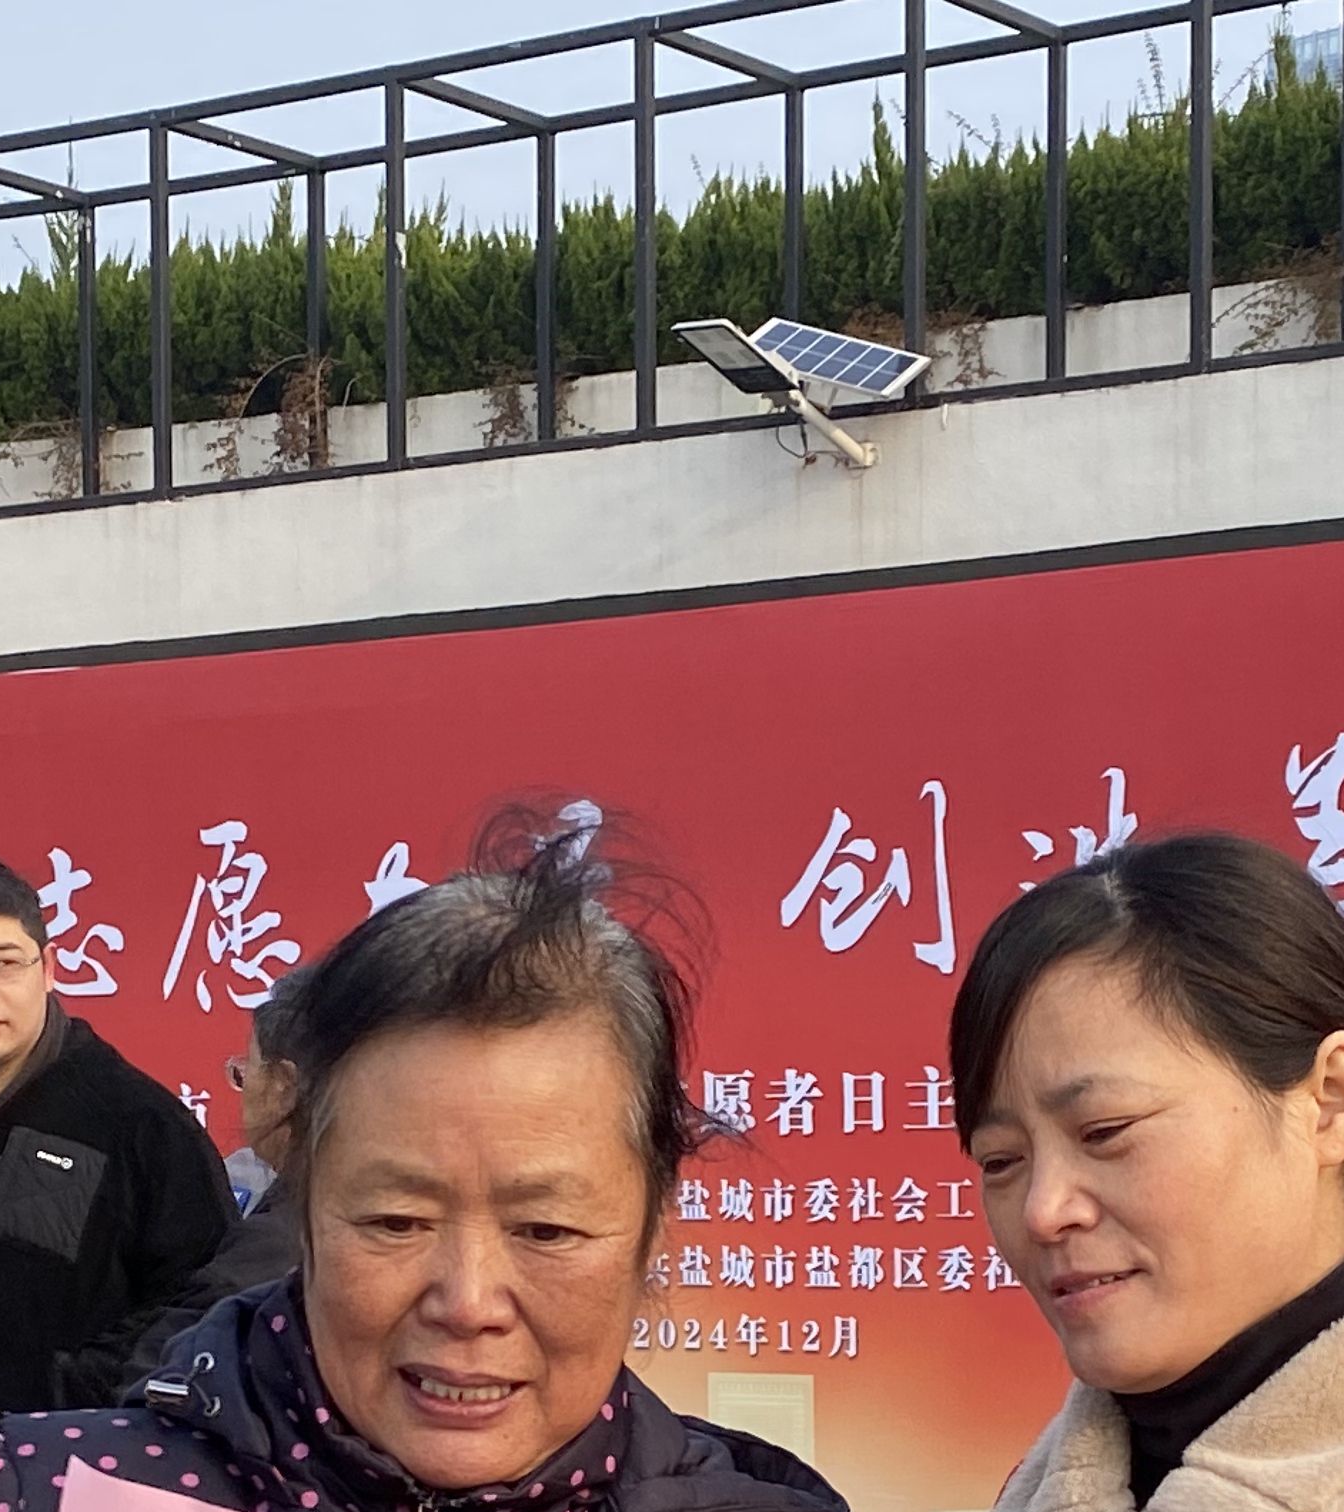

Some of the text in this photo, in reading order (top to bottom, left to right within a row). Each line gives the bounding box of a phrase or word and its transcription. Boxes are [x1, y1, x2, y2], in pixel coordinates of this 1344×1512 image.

[680, 1065, 957, 1136] 愿者日主
[632, 1313, 860, 1359] 2024年12月
